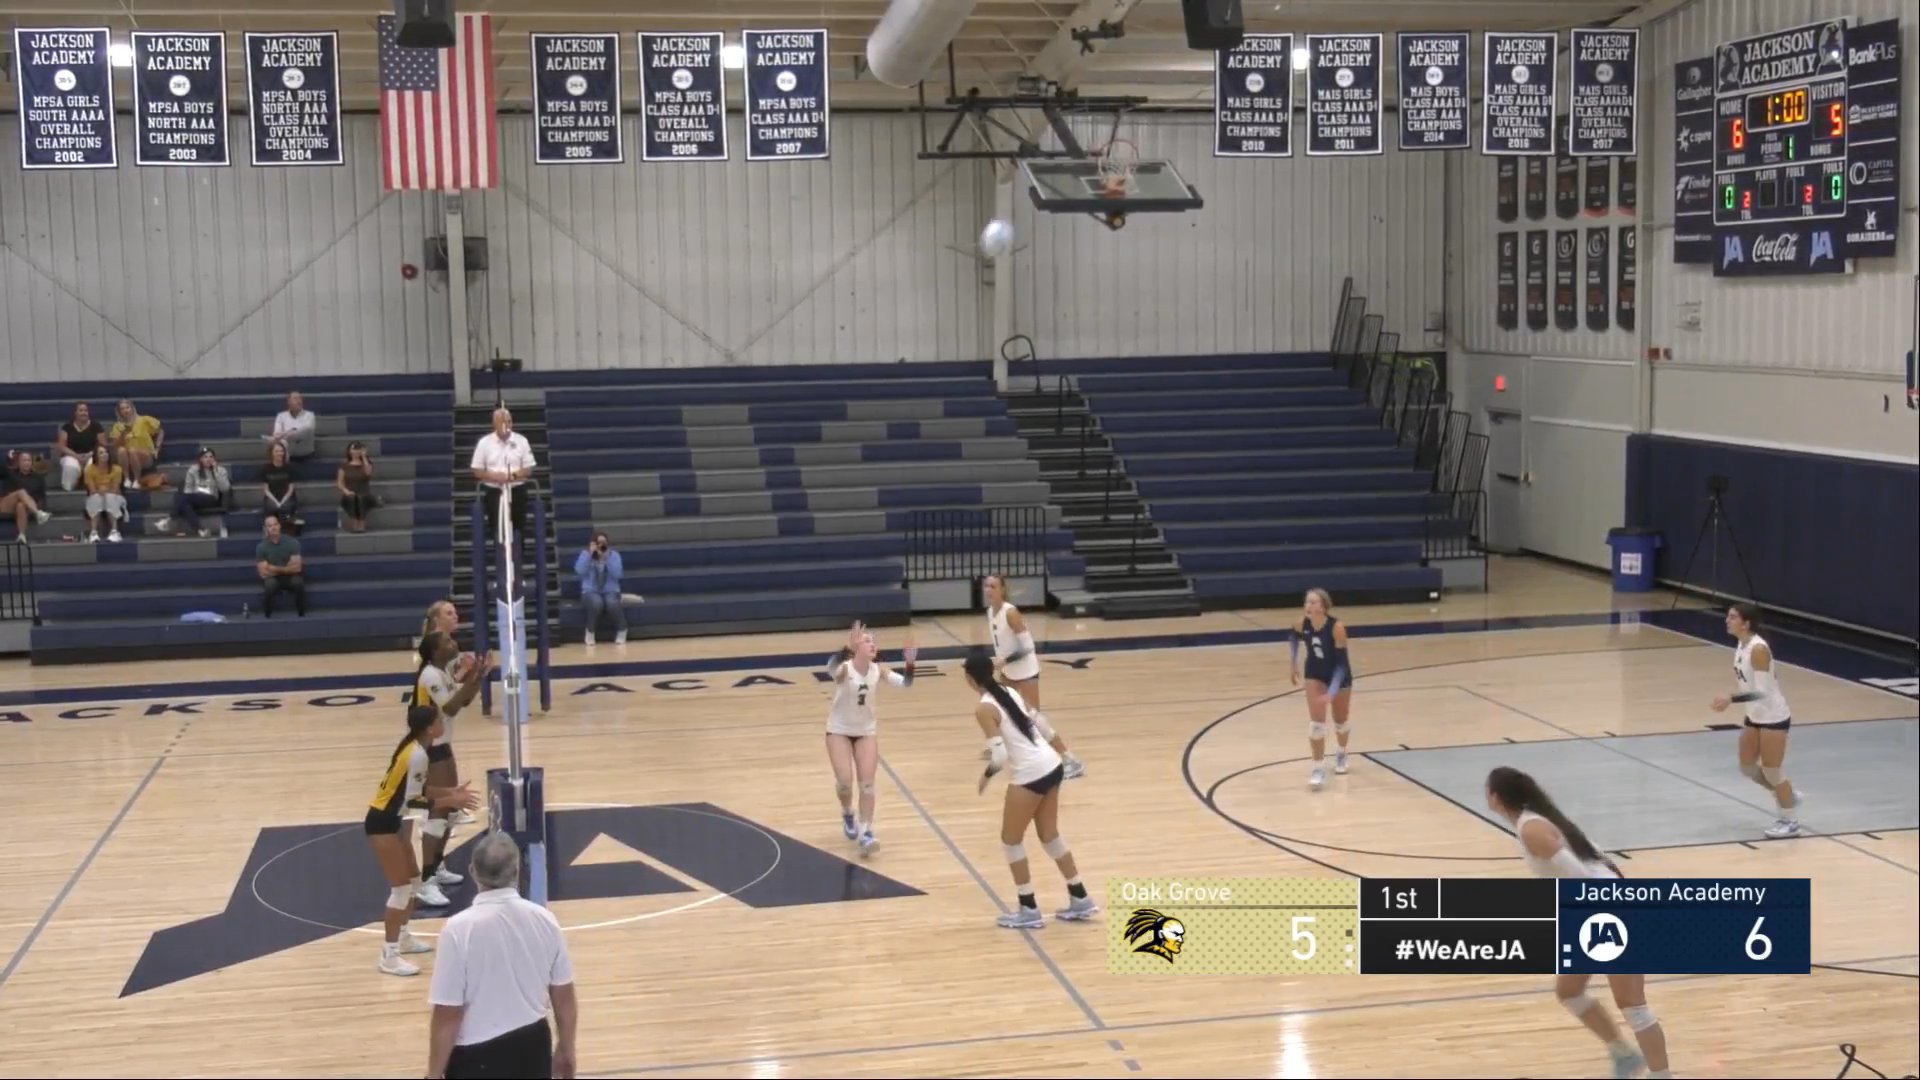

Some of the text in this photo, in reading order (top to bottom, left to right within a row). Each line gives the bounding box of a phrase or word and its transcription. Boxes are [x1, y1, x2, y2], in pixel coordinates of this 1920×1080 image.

[31, 34, 94, 48] JACKSON
[147, 38, 210, 52] JACKSON
[262, 38, 321, 52] JACKSON
[546, 39, 605, 53] JACKSON
[652, 38, 710, 52] JACKSON
[757, 35, 814, 49] JACKSON
[1319, 39, 1371, 52] JACKSON
[1409, 40, 1459, 53] JACKSON
[1496, 40, 1546, 52] JACKSON
[1580, 35, 1630, 48] JACKSON
[1744, 30, 1815, 61] JACKSON
[32, 51, 95, 65] ACADEMY
[262, 53, 323, 67] ACADEMY
[652, 54, 711, 68] ACADEMY
[756, 52, 815, 66] ACADEMY
[1318, 53, 1372, 67] ACADEMY
[1409, 54, 1460, 67] ACADEMY
[1495, 53, 1547, 65] ACADEMY
[1579, 49, 1630, 61] ACADEMY
[148, 56, 211, 70] ACADEMY
[546, 57, 606, 71] ACADEMY
[1227, 55, 1282, 68] ACADEMY
[1741, 54, 1817, 85] ACADEMY
[1318, 88, 1372, 100] MAIS GIRLS
[1410, 87, 1460, 97] MAIS BOYS
[1494, 84, 1546, 95] MAIS GIRLS
[1579, 85, 1628, 95] MAIS GIRLS
[1811, 82, 1845, 100] VISITOR
[33, 95, 100, 107] MPSA GIRLS
[262, 90, 326, 102] MPSA BOYS
[655, 91, 712, 102] MPSA BOYS
[1488, 95, 1514, 105] CLASS
[1515, 95, 1540, 105] AAAA
[1574, 96, 1599, 106] CLASS
[149, 102, 213, 114] MPSA BOYS
[262, 103, 328, 114] NORTH AAA
[547, 101, 608, 112] MPSA BOYS
[759, 97, 816, 110] MPSA BOYS
[1227, 97, 1282, 108] MAIS GIRLS
[1312, 102, 1342, 113] CLASS
[1345, 101, 1365, 112] AAA
[1403, 98, 1431, 108] CLASS
[1433, 98, 1452, 108] AAA
[1720, 99, 1742, 116] HOME
[1767, 91, 1806, 124] 1:00
[30, 110, 105, 121] SOUTH AAAA
[647, 105, 679, 116] CLASS
[683, 105, 705, 116] AAA
[1408, 109, 1461, 120] CLASS AAA
[1489, 106, 1548, 117] CLASS AAAA
[1576, 107, 1630, 117] CLASS AAAA
[263, 114, 328, 126] CLASS AAA
[541, 116, 575, 127] CLASS
[577, 116, 601, 127] AAA
[751, 114, 784, 125] CLASS
[787, 113, 810, 124] AAA
[1221, 111, 1252, 122] CLASS
[1254, 112, 1275, 123] AAA
[1318, 114, 1371, 125] CLASS AAA
[1497, 117, 1541, 127] OVERALL
[1582, 118, 1623, 127] OVERALL
[1831, 103, 1842, 136] 5
[40, 123, 95, 135] OVERALL
[148, 118, 215, 129] NORTH AAA
[659, 118, 709, 129] OVERALL
[1407, 120, 1462, 131] CHAMPIONS
[270, 126, 323, 137] OVERALL
[548, 131, 609, 143] CHAMPIONS
[655, 131, 715, 142] CHAMPIONS
[758, 127, 818, 140] CHAMPIONS
[1227, 126, 1281, 137] CHAMPIONS
[1318, 126, 1372, 137] CHAMPIONS
[1423, 132, 1445, 142] 2014
[1492, 127, 1545, 138] CHAMPIONS
[1578, 129, 1627, 139] CHAMPIONS
[1732, 119, 1743, 149] 6
[35, 137, 102, 149] CHAMPIONS
[149, 133, 215, 144] CHAMPIONS
[265, 138, 329, 149] CHAMPIONS
[1334, 139, 1354, 150] 2011
[672, 145, 698, 155] 2006
[776, 143, 801, 154] 2007
[1242, 140, 1265, 151] 2010
[55, 152, 85, 162] 2002
[169, 149, 197, 160] 2003
[282, 150, 311, 160] 2004
[565, 147, 592, 157] 2005
[1823, 162, 1843, 174] FOULS
[1804, 185, 1812, 202] 2
[1831, 175, 1841, 200] 0
[1725, 186, 1734, 209] 0
[1743, 191, 1750, 208] 2
